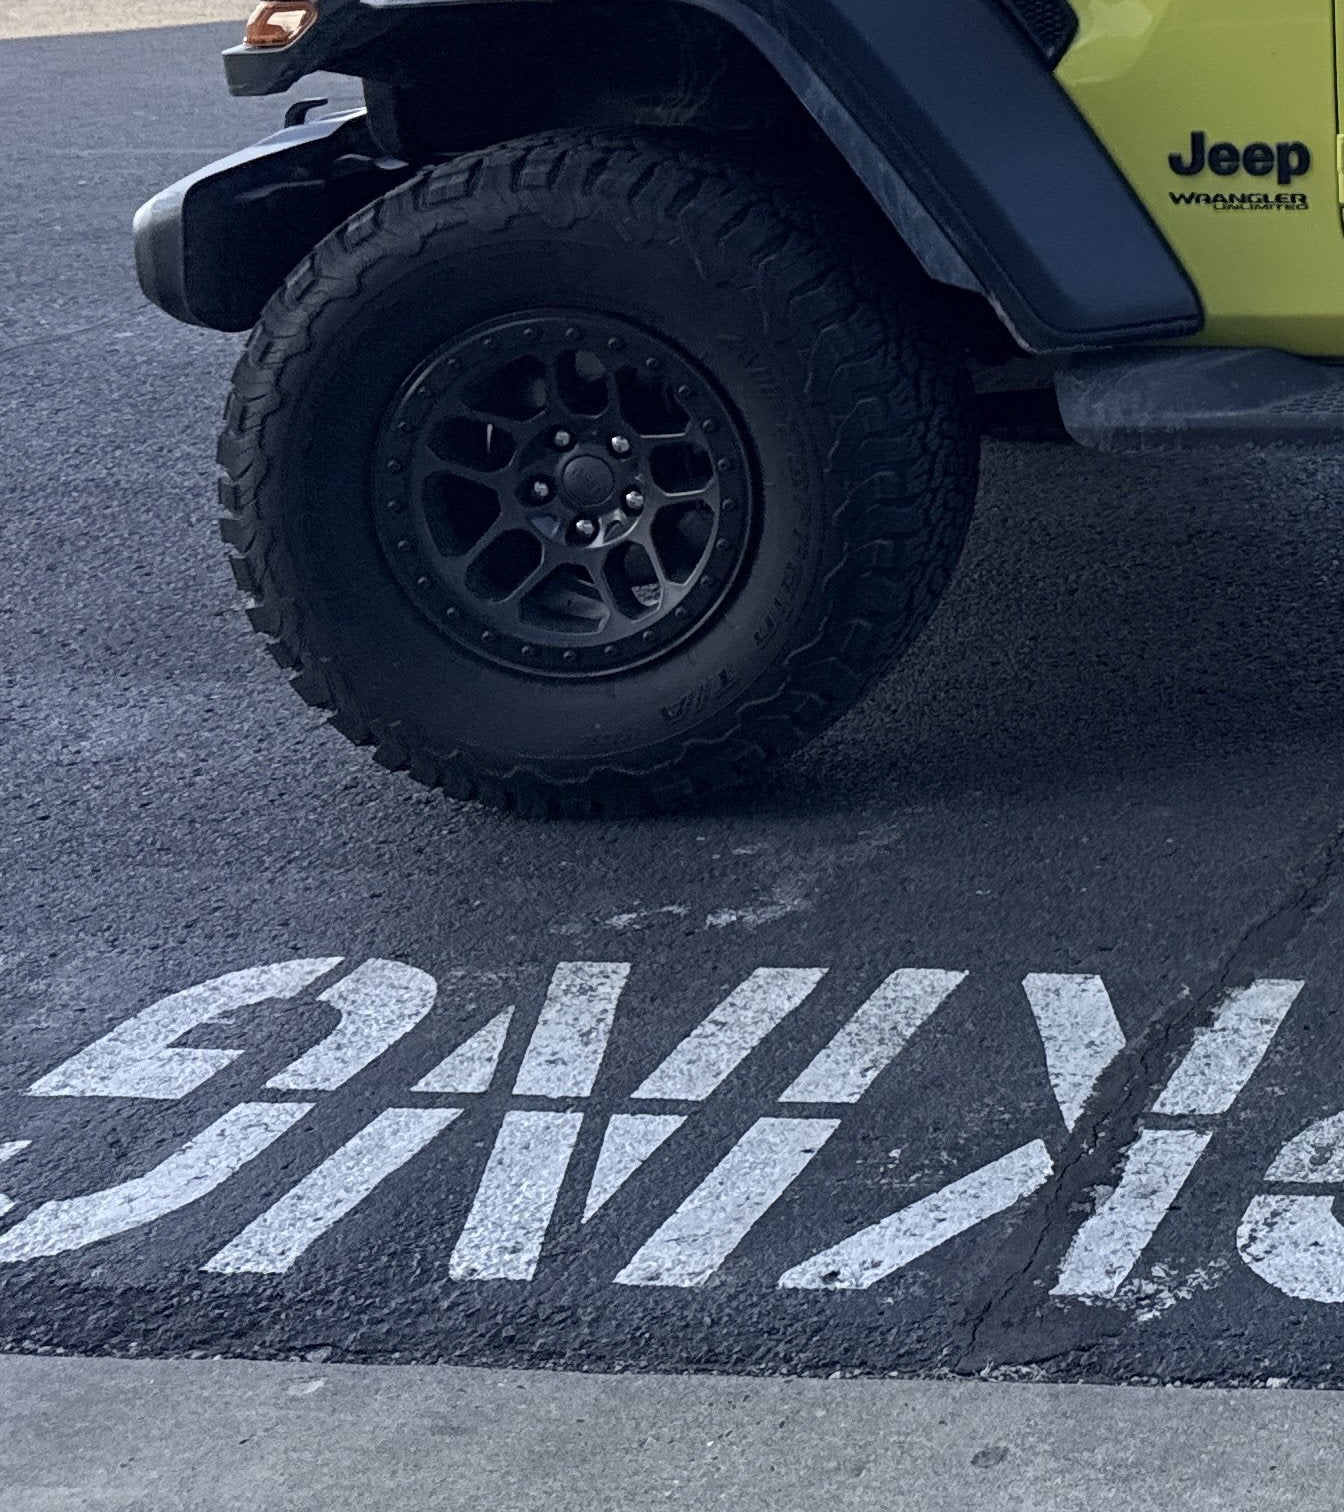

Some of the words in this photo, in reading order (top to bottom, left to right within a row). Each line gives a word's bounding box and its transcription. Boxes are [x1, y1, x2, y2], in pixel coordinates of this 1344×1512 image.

[1168, 130, 1311, 186] Jeep
[1168, 191, 1308, 206] WRANGLER
[1212, 200, 1310, 212] UNLIMITED
